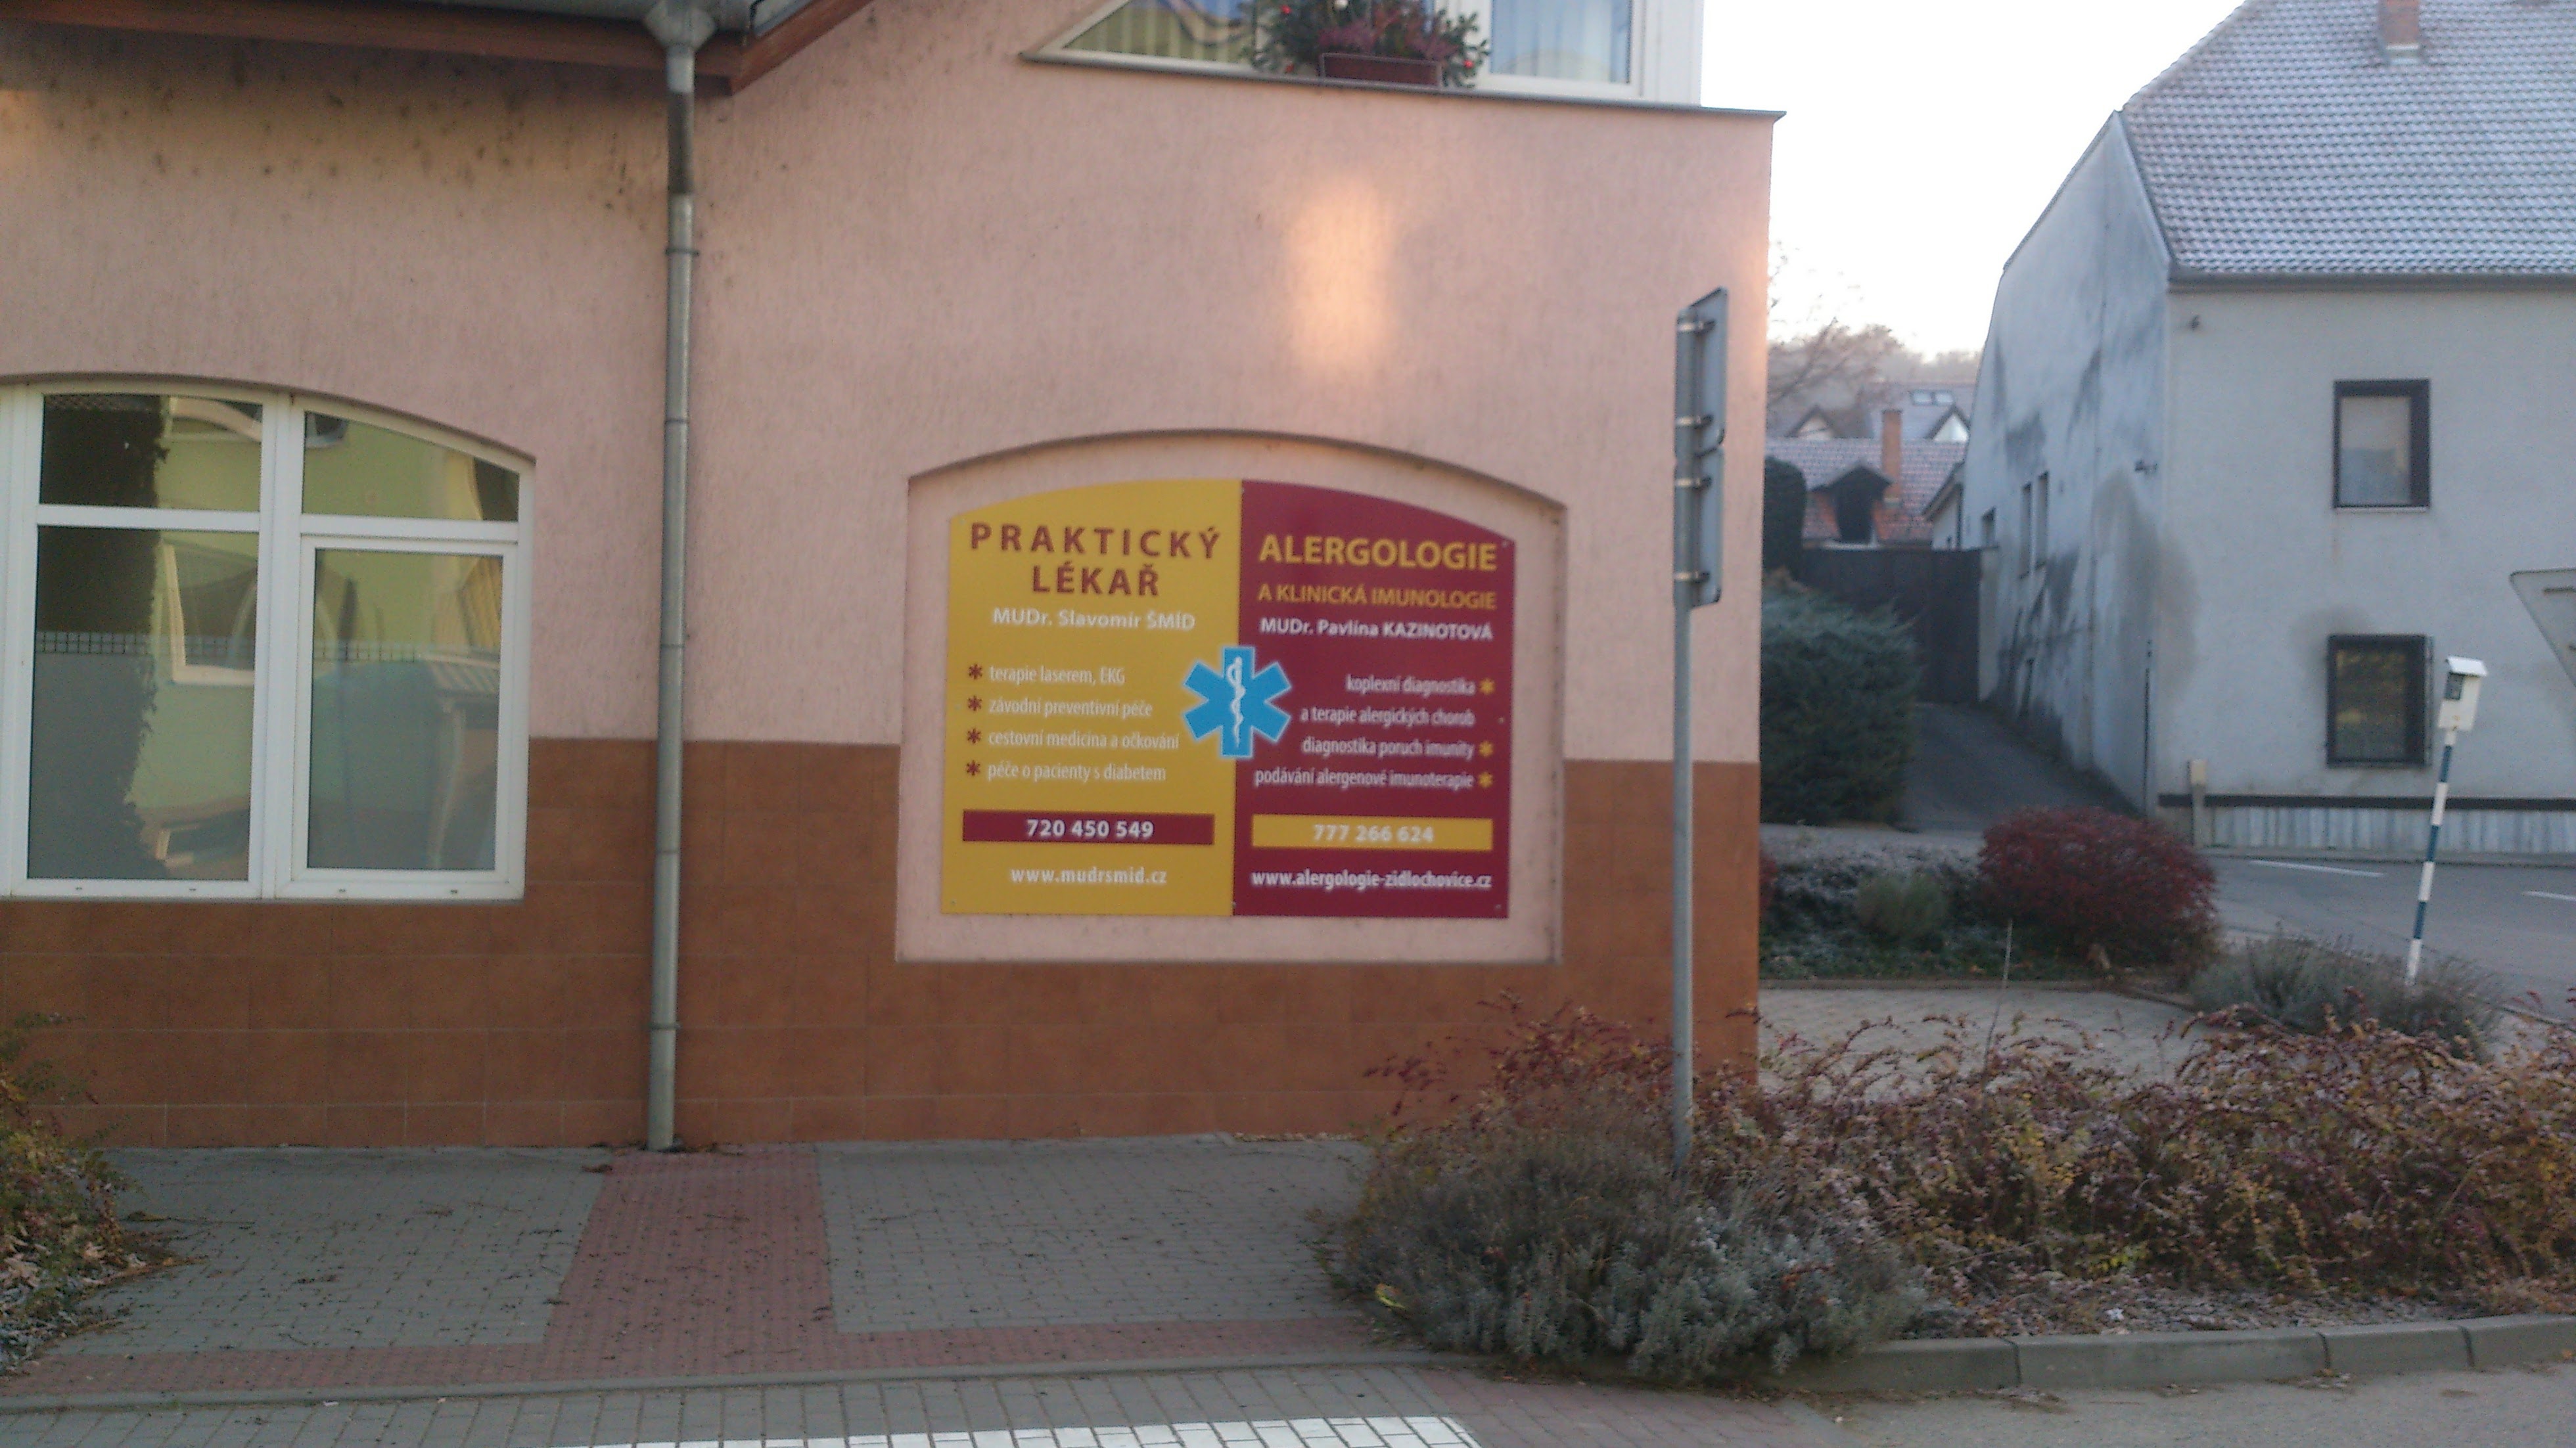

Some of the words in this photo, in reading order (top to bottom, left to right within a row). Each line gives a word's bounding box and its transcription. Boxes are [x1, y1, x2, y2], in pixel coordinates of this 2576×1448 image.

[971, 522, 1220, 559] PRAKTICKÝ
[1258, 534, 1498, 572] ALERGOLOGIE
[1032, 561, 1159, 597] LÉKAŘ
[1258, 583, 1272, 601] A
[1277, 583, 1367, 605] KLINICKÁ
[1373, 588, 1497, 610] IMUNOLOGIE
[993, 608, 1052, 625] MUDr.
[1260, 617, 1314, 635] MUDr.
[990, 666, 1036, 685] terapie
[1041, 666, 1096, 685] laserem,
[1100, 667, 1125, 685] EKG
[1404, 677, 1475, 698] diagnostika
[989, 697, 1041, 715] závodní
[1044, 699, 1118, 718] preventivní
[1300, 710, 1308, 721] a
[1312, 708, 1356, 725] terapie
[1360, 707, 1429, 727] alergických
[988, 729, 1044, 746] cestovní
[1111, 735, 1118, 748] a
[1303, 736, 1375, 756] diagnostika
[1379, 740, 1422, 757] poruch
[1426, 740, 1475, 760] imunity
[987, 761, 1019, 782] péče
[1023, 767, 1030, 777] o
[1034, 762, 1091, 782] pacienty
[1095, 769, 1099, 779] s
[1103, 763, 1166, 781] diabetem
[1255, 769, 1314, 786] podávání
[1390, 770, 1474, 790] imunoterapie
[1027, 819, 1065, 837] 720
[1072, 819, 1109, 838] 450
[1116, 821, 1154, 838] 549
[1314, 824, 1348, 841] 777
[1356, 825, 1392, 842] 266
[1397, 826, 1434, 843] 624
[1009, 866, 1167, 885] www.mudrsmid.cz
[1251, 869, 1492, 892] www.alergologie-zidlochovice.cz
